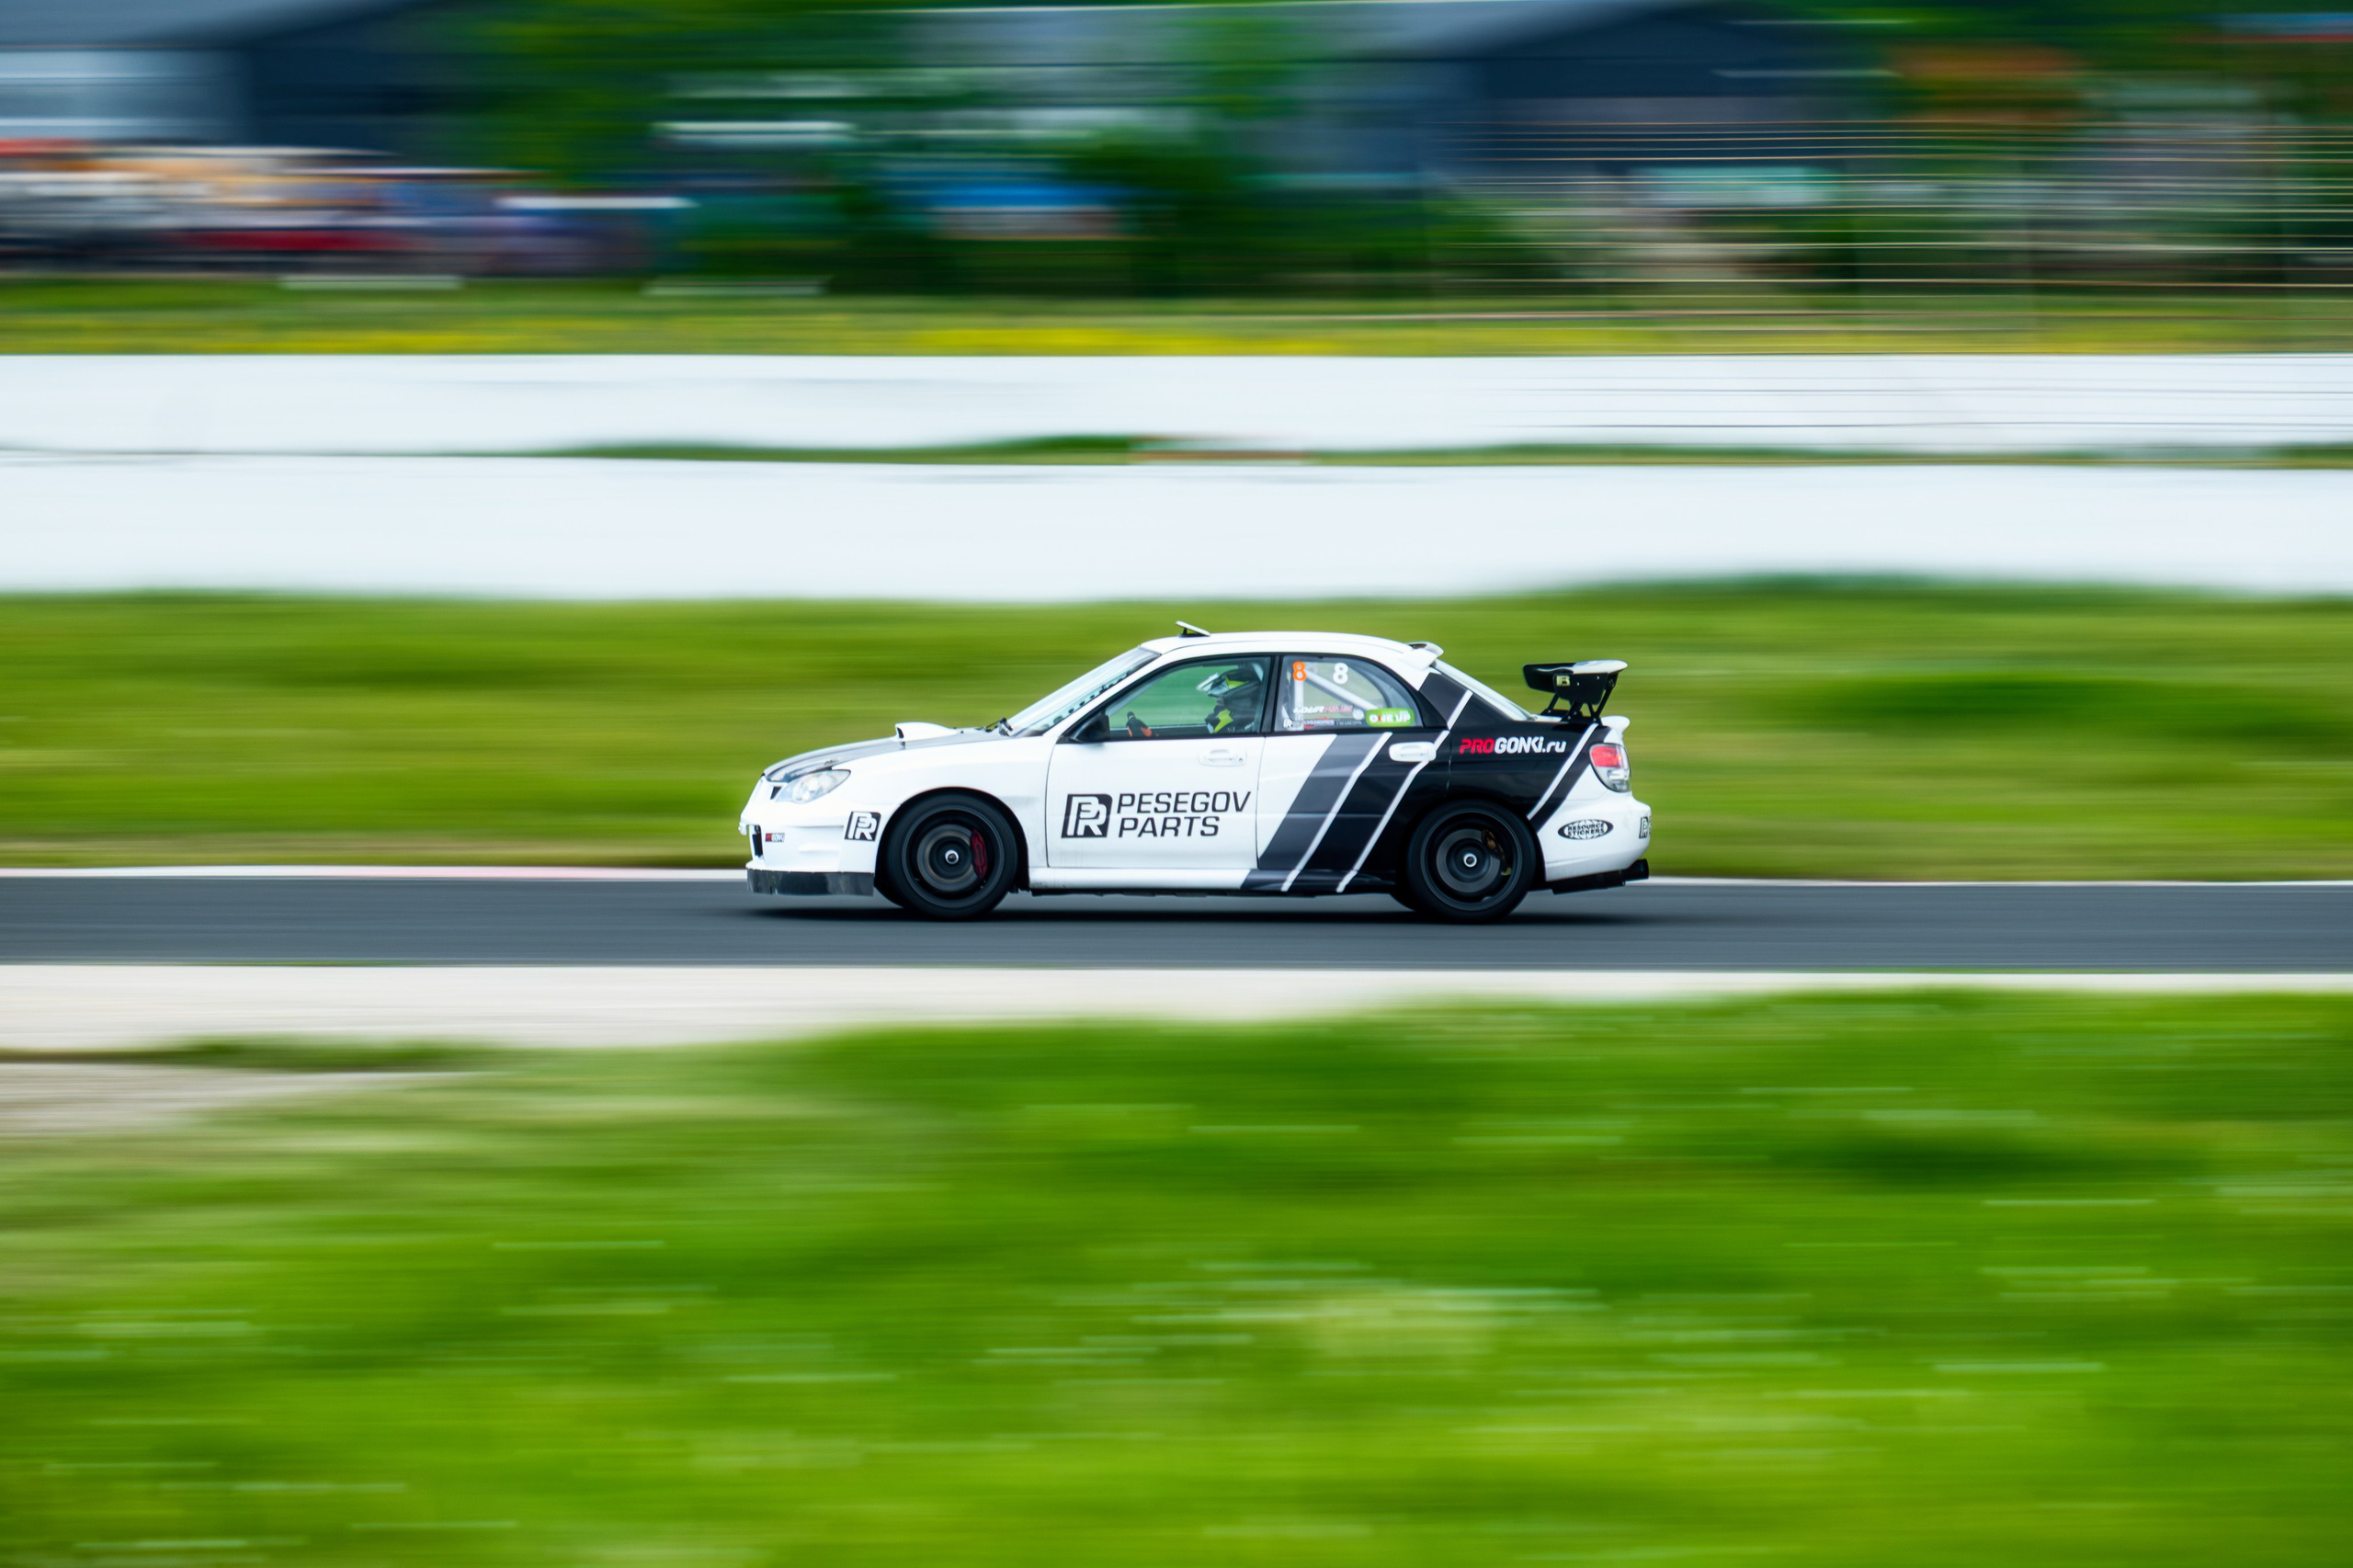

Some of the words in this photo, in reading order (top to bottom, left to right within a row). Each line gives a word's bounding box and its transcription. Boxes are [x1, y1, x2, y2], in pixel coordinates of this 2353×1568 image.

[1292, 661, 1307, 682] 8
[1333, 662, 1348, 685] 8
[1117, 791, 1251, 814] PESEGOV
[1118, 816, 1220, 838] PARTS
[1567, 823, 1605, 831] RESOURCE
[1567, 828, 1605, 836] STICKERS
